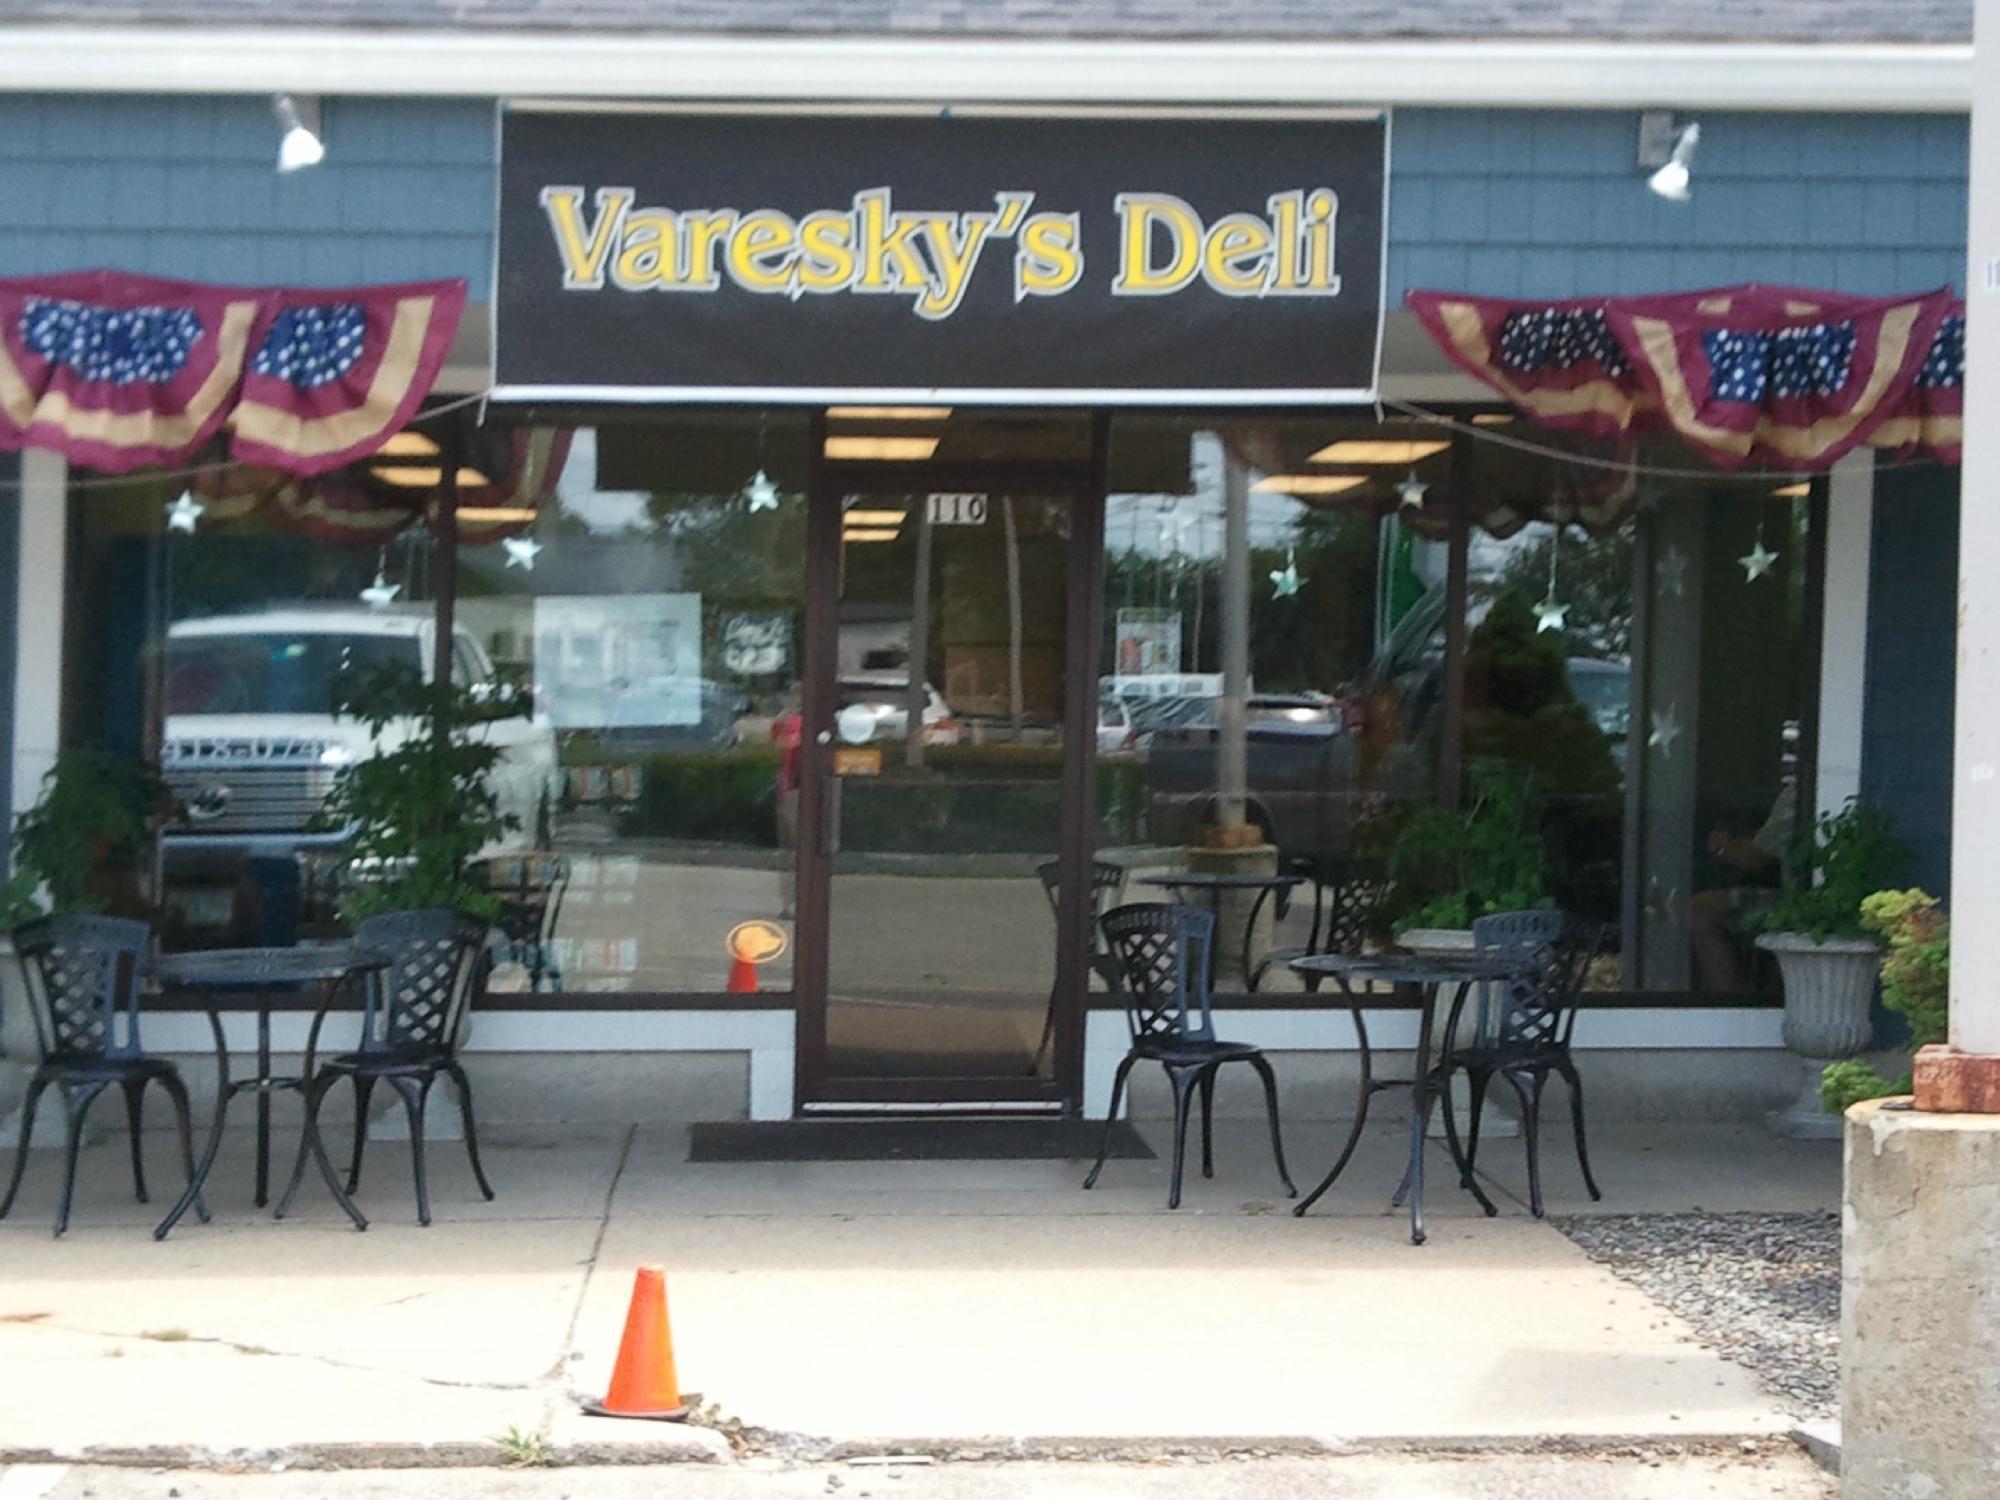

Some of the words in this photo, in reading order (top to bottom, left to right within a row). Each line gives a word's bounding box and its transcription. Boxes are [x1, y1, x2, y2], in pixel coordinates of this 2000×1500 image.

[541, 185, 1083, 321] Varesky's
[1113, 188, 1341, 299] Deli
[931, 495, 985, 522] 110
